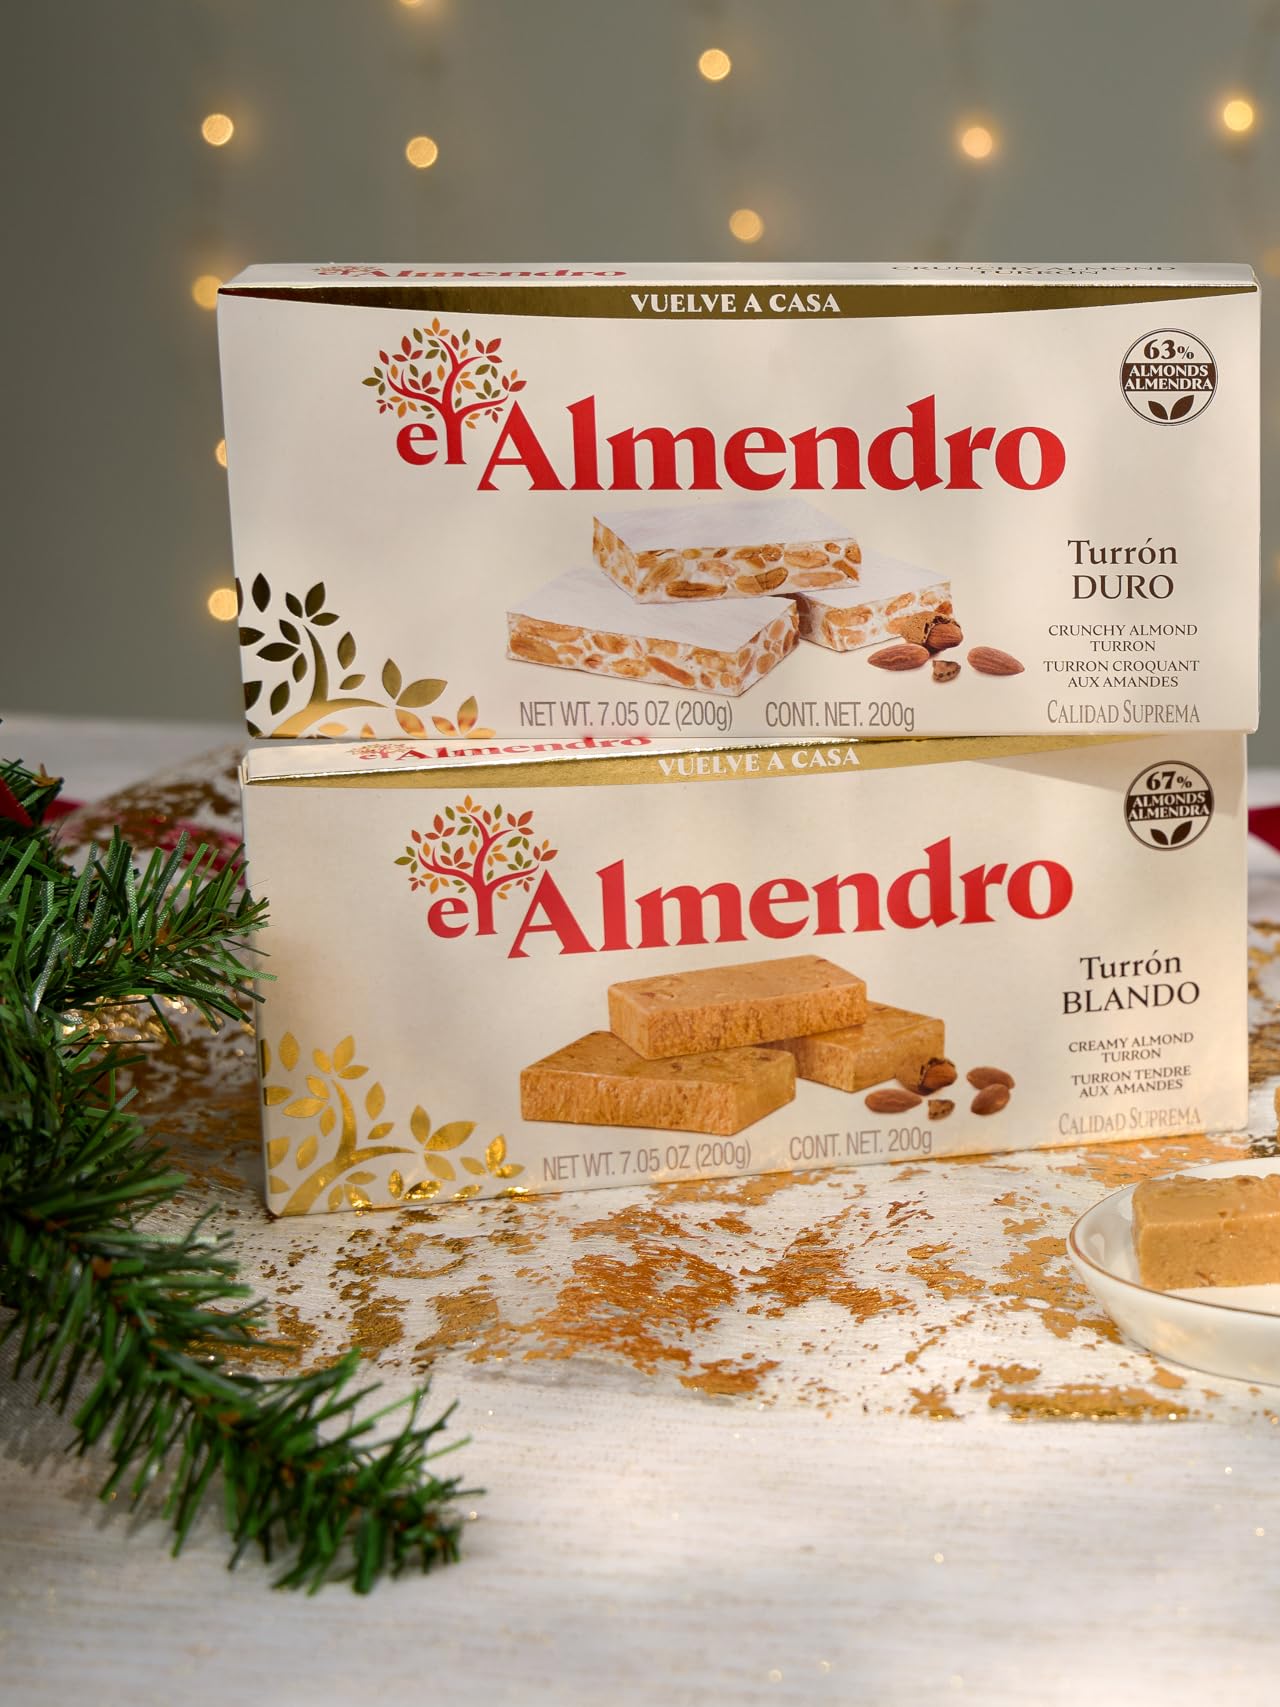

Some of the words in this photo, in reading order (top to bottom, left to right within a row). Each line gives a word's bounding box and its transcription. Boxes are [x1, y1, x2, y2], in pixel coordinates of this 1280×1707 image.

[354, 269, 627, 278] Almendro
[631, 293, 736, 313] VUELVE
[743, 293, 763, 313] A
[769, 293, 841, 313] CASA
[1143, 339, 1195, 361] 63%
[1129, 364, 1209, 378] ALMONDS
[1124, 378, 1214, 392] ALMENDRA
[476, 394, 1067, 492] Almendro
[1067, 537, 1178, 565] Turrón
[1071, 574, 1174, 600] DURO
[1048, 624, 1126, 637] CRUNCHY
[1129, 624, 1198, 636] ALMOND
[1089, 640, 1156, 652] TURRON
[1043, 660, 1109, 672] TURRON
[1112, 660, 1200, 674] CROQUANT
[1067, 676, 1100, 688] AUX
[1102, 676, 1179, 688] AMANDES
[520, 702, 556, 727] NET
[561, 702, 593, 727] WT.
[597, 702, 640, 727] 7.05
[644, 702, 670, 727] OZ
[675, 701, 733, 732] (200g)
[765, 702, 820, 728] CONT.
[825, 702, 864, 727] NET.
[868, 702, 915, 732] 200g
[395, 737, 652, 761] Almendro
[657, 753, 760, 777] VUELVE
[766, 751, 785, 771] A
[790, 747, 860, 768] CASA
[1145, 771, 1193, 791] 67%
[1132, 792, 1206, 807] ALMONDS
[1128, 805, 1210, 821] ALMENDRA
[507, 836, 1074, 960] Almendro
[1079, 949, 1182, 981] Turrón
[1062, 981, 1200, 1015] BLANDO
[1068, 1037, 1129, 1053] CREAMY
[1131, 1032, 1194, 1048] ALMOND
[1101, 1048, 1161, 1064] TURRON
[1071, 1070, 1131, 1086] TURRON
[1134, 1065, 1192, 1080] TENDRE
[1079, 1085, 1109, 1098] AUX
[1113, 1078, 1184, 1095] AMANDES
[543, 1155, 580, 1181] NET
[583, 1153, 615, 1177] WT.
[621, 1148, 660, 1174] 7.05
[666, 1145, 690, 1170] OZ
[695, 1139, 751, 1171] (200g)
[789, 1133, 842, 1161] CONT.
[846, 1129, 883, 1156] NET.
[887, 1126, 932, 1154] 200g
